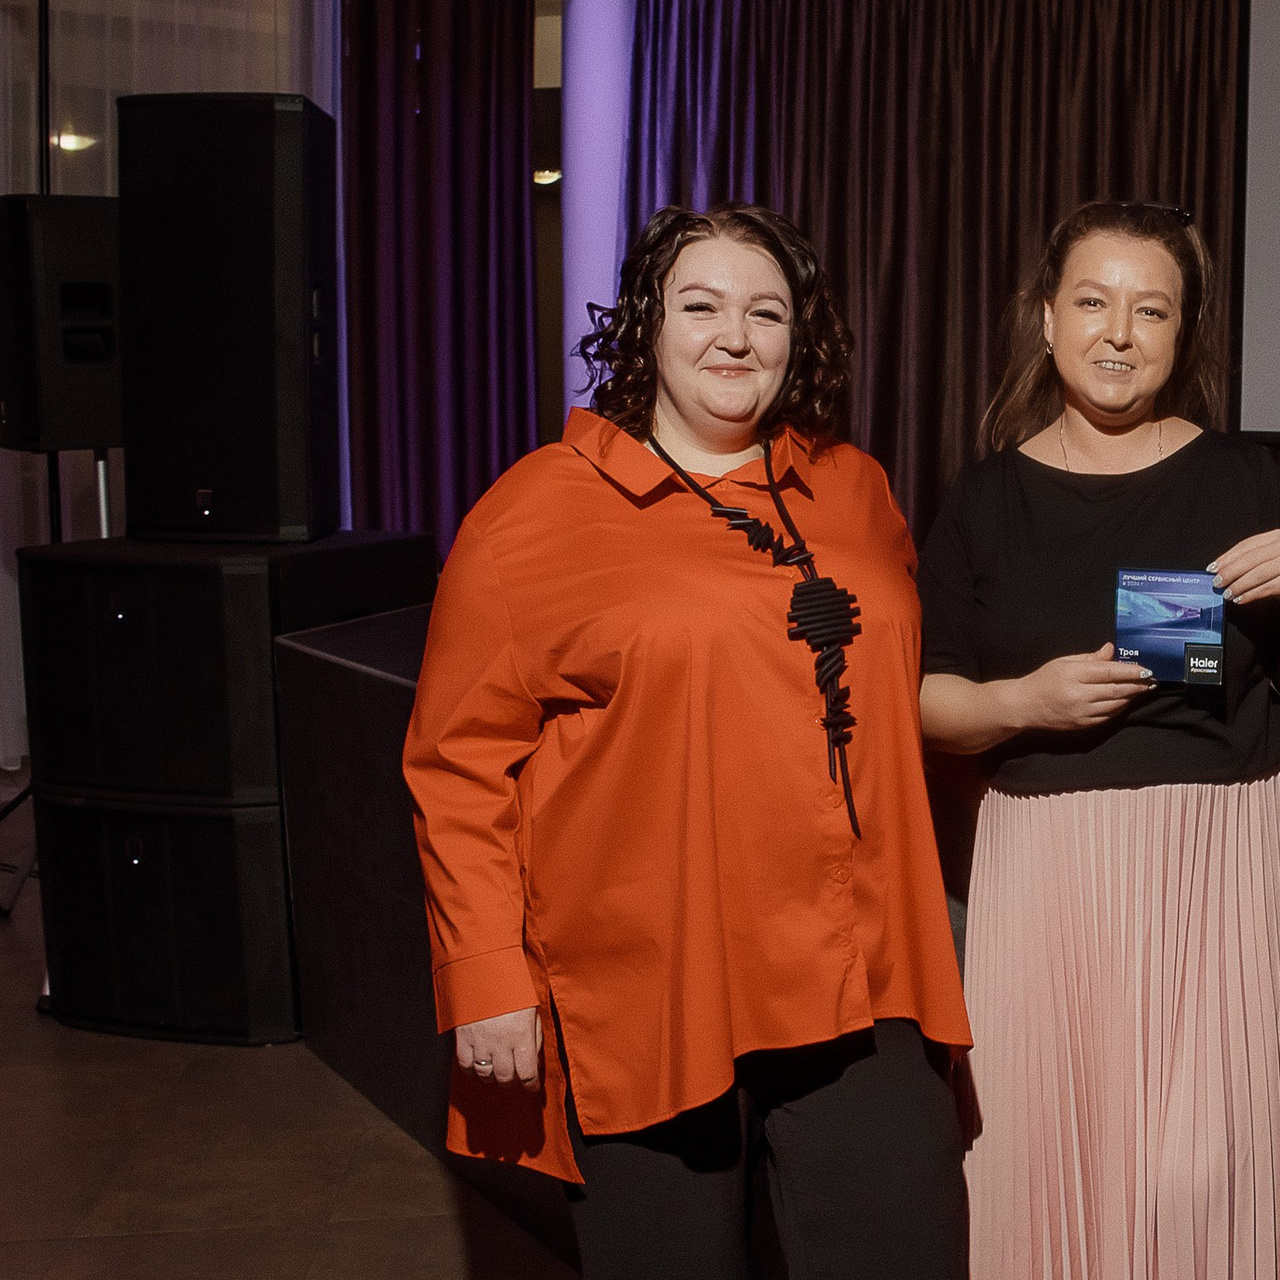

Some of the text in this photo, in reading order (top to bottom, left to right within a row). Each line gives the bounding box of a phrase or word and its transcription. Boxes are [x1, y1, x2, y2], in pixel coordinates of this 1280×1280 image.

[1148, 575, 1182, 583] СЕРВИСНЫЙ
[1119, 648, 1139, 658] Троя
[1190, 657, 1219, 669] Haier
